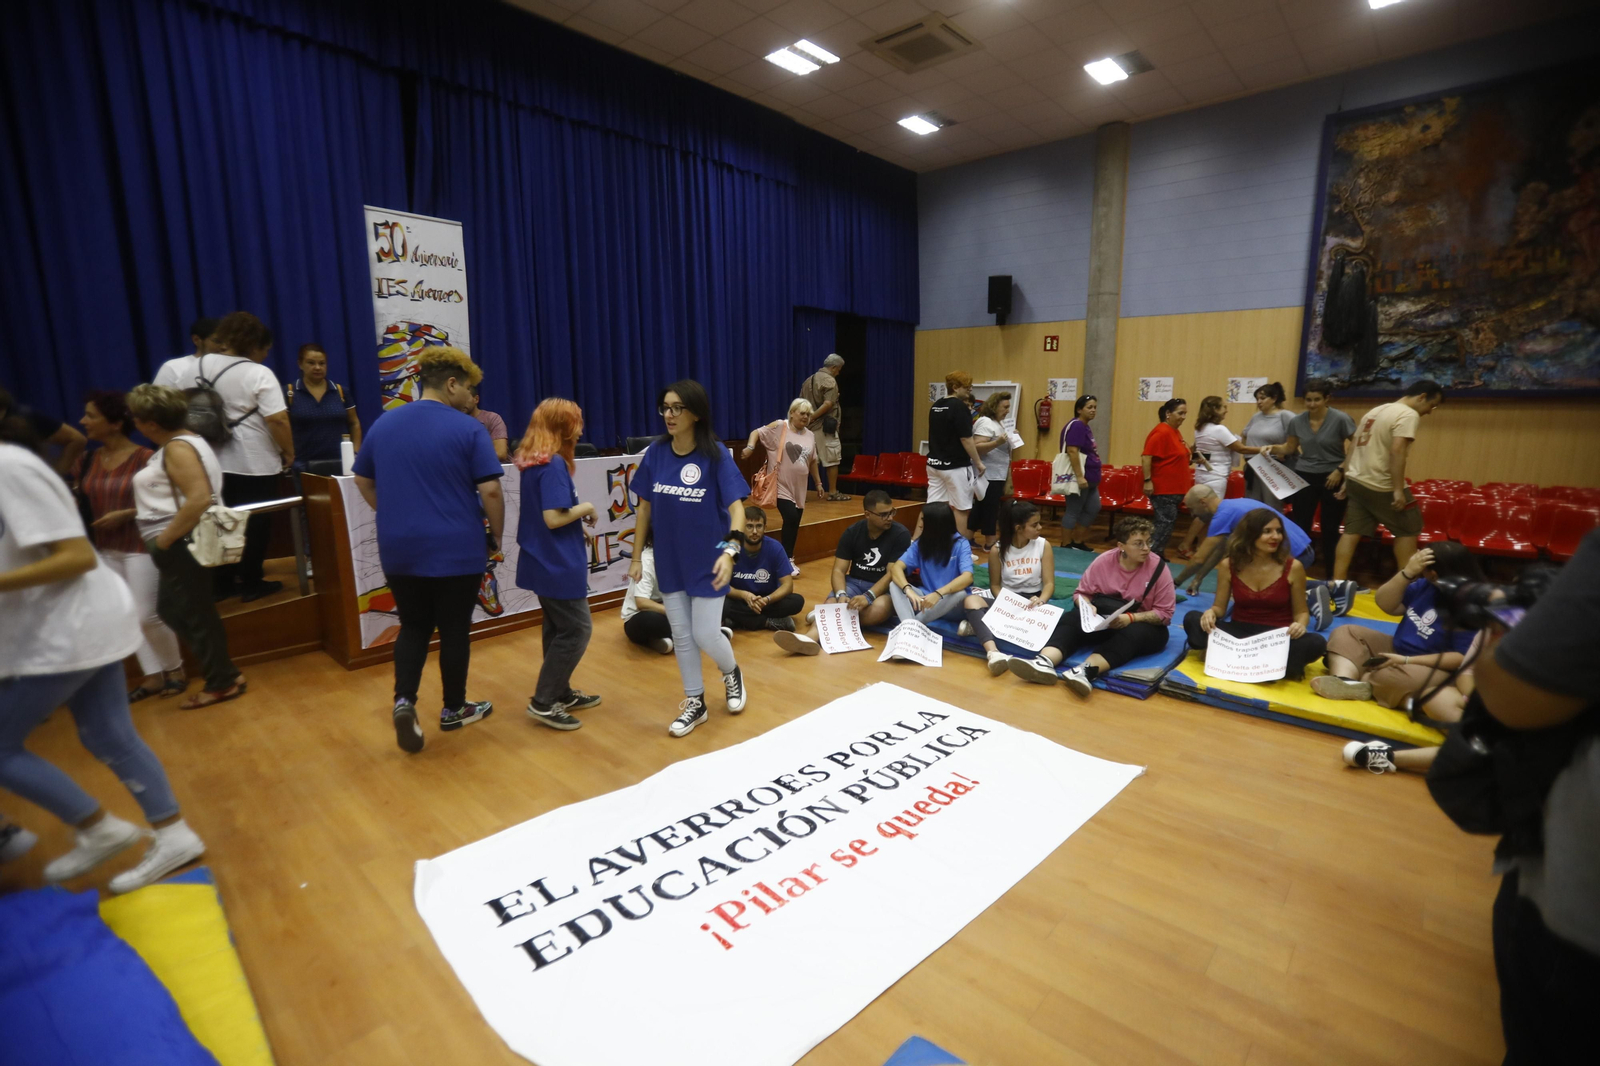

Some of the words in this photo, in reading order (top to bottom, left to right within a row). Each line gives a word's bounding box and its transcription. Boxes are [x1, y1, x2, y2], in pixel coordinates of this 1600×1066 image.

[374, 277, 408, 298] IES
[1006, 557, 1039, 568] DETROIT
[1014, 567, 1032, 575] TEAM
[1004, 595, 1055, 617] admstrativo
[820, 608, 831, 645] recortes
[835, 607, 848, 647] pagamos
[1026, 616, 1036, 625] de
[1037, 621, 1049, 631] No
[1213, 631, 1221, 639] El
[483, 876, 580, 929] EL
[587, 763, 832, 887] AVERROES
[824, 727, 909, 771] POR
[895, 708, 951, 736] LA
[513, 794, 851, 974] EDUCACIÓN
[837, 721, 992, 806] PÚBLICA
[699, 862, 829, 951] ¡Pilar
[829, 838, 880, 870] se
[875, 771, 981, 841] queda!
